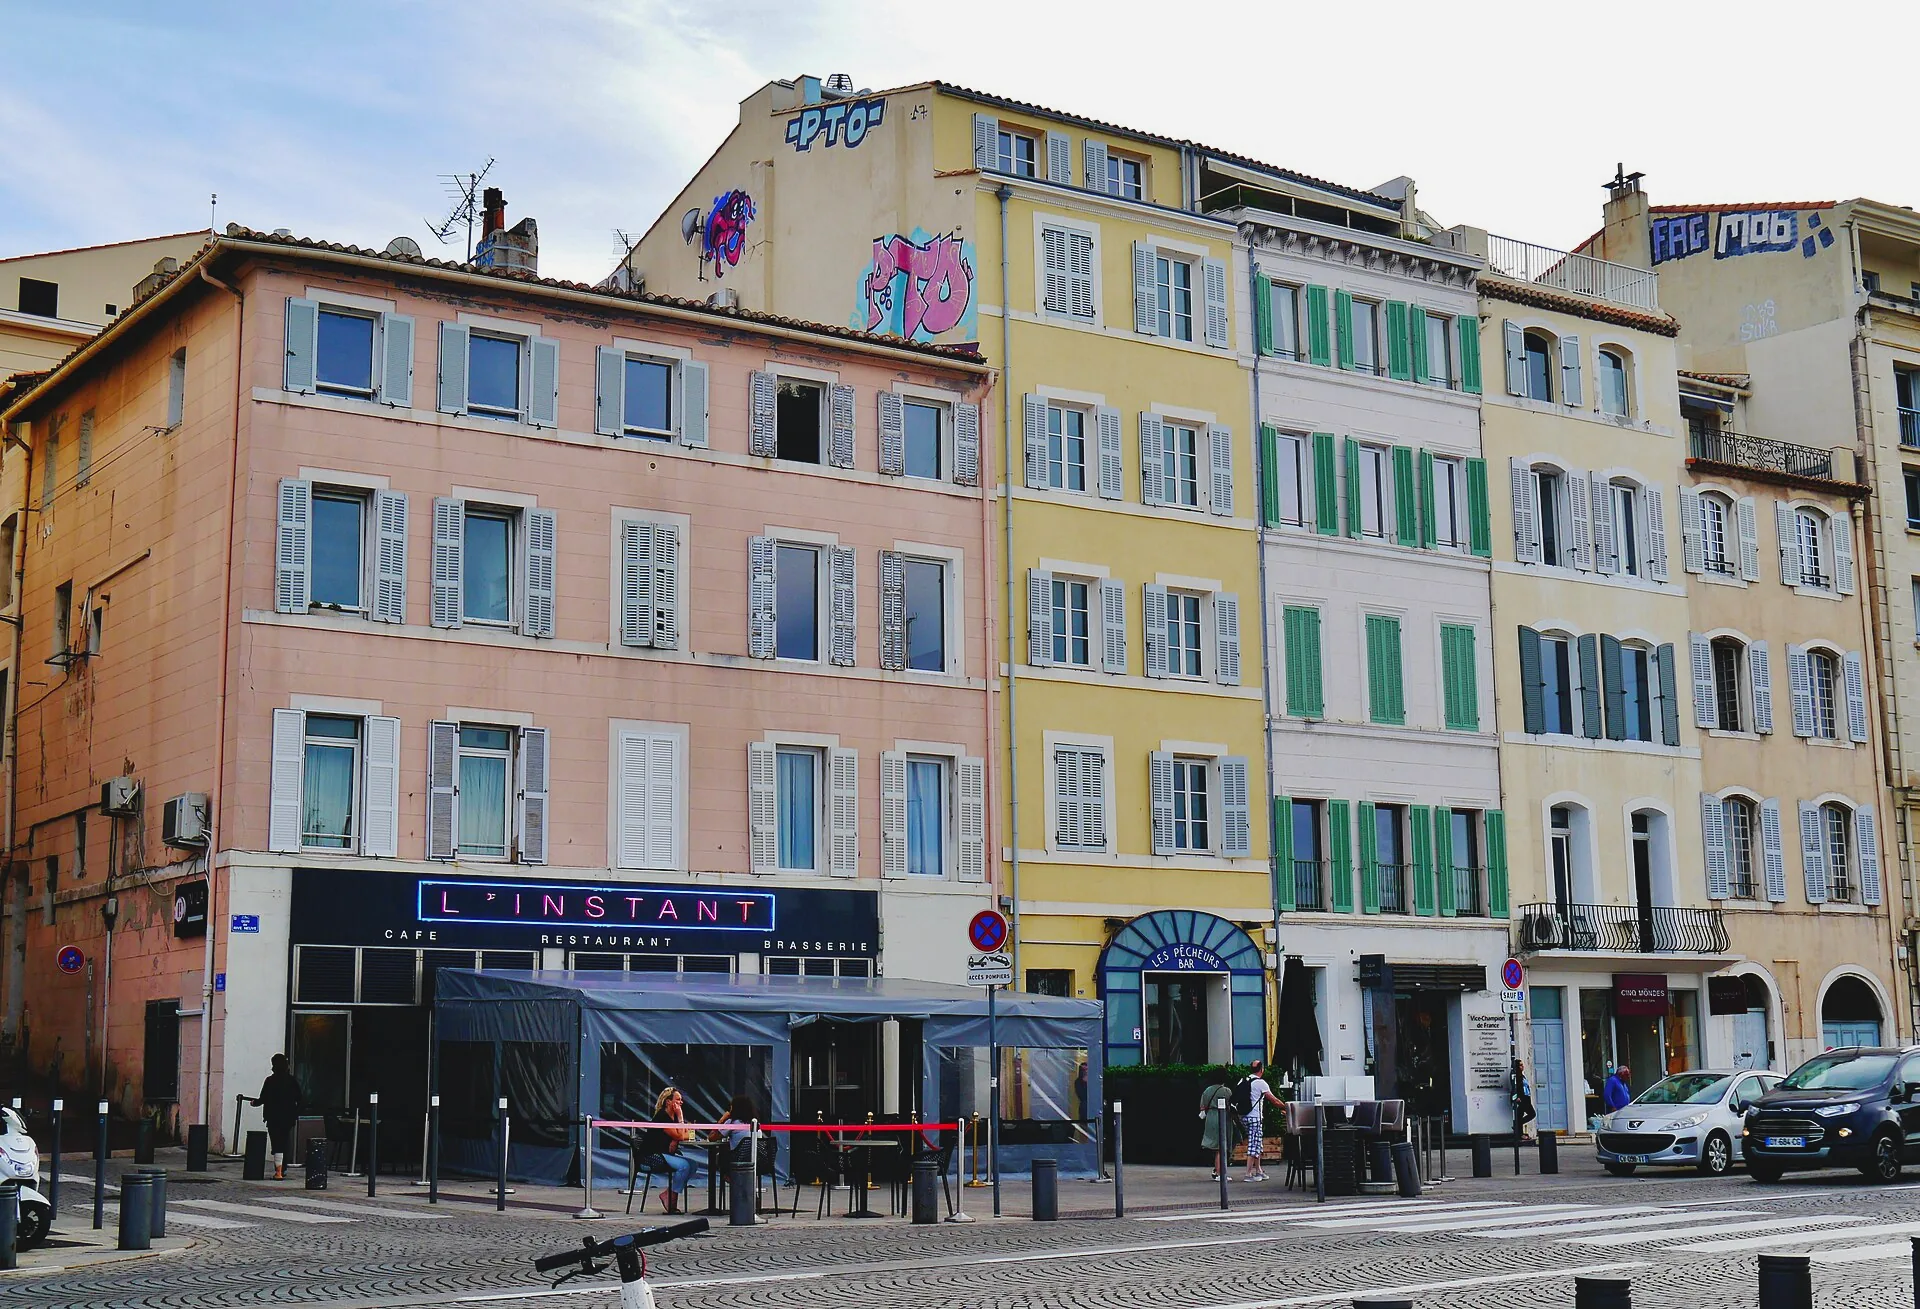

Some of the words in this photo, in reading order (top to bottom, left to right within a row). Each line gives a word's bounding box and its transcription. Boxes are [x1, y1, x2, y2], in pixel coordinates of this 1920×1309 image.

[441, 891, 755, 923] L'INSTANT
[384, 929, 438, 941] CAFE
[541, 934, 672, 947] RESTAURANT
[764, 939, 868, 952] BRASSERIE
[1151, 950, 1169, 968] LES
[1178, 958, 1195, 968] BAR
[1503, 991, 1517, 1000] SAUF
[1470, 1015, 1505, 1023] Vice-Champion
